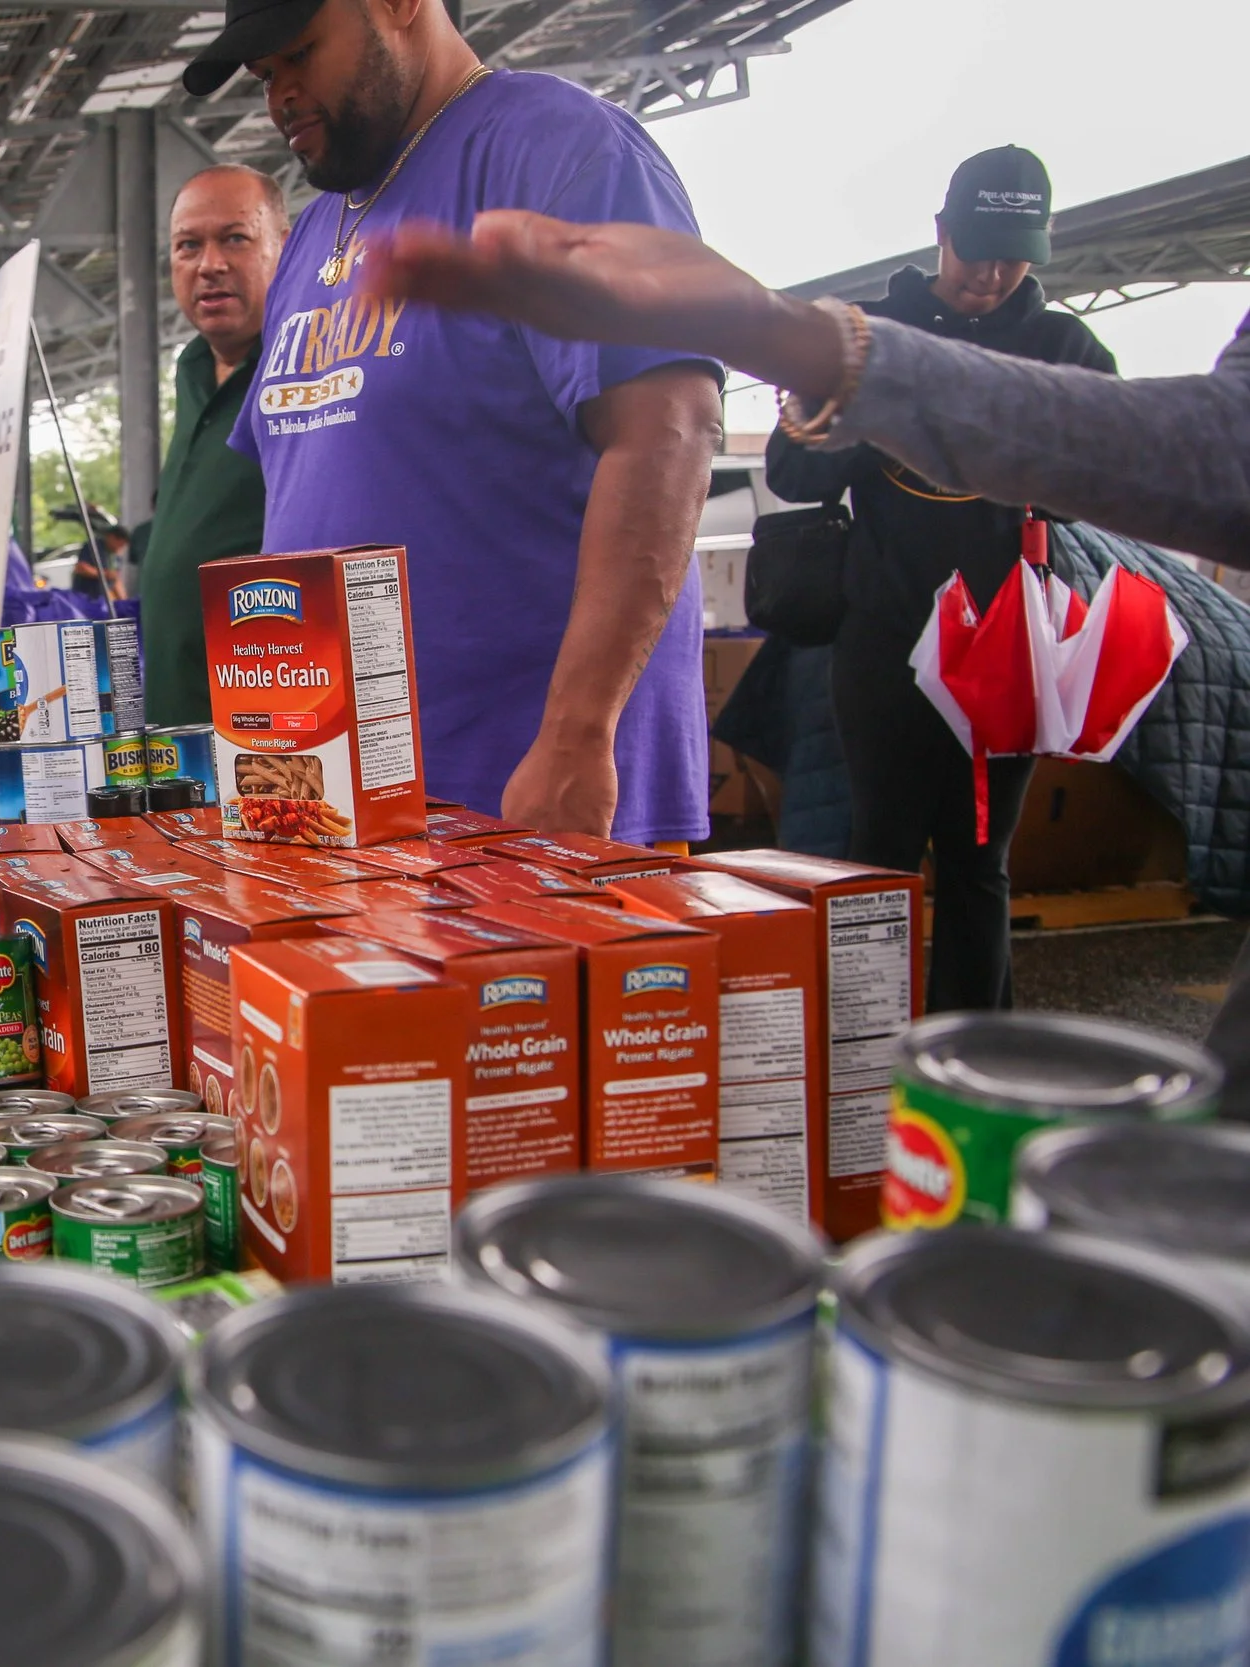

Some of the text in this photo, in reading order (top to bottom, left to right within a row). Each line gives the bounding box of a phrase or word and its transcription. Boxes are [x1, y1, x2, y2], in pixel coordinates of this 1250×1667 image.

[978, 190, 1042, 201] PHILABUNDANCE
[277, 374, 344, 408] FEST
[267, 420, 280, 435] The
[280, 417, 306, 434] Malcolm
[323, 407, 356, 426] Foundation
[345, 559, 396, 570] Nutrition Facts
[347, 584, 398, 599] Calories 180
[233, 589, 296, 617] RONZONI
[233, 643, 303, 658] Healthy Harvest
[215, 662, 330, 688] Whole Grain
[252, 738, 297, 750] Penne Rigate
[108, 749, 147, 771] BUSH
[150, 748, 175, 766] SH'S
[831, 893, 906, 909] Nutrition Facts
[78, 913, 157, 929] Nutrition Facts
[80, 935, 102, 943] Serving
[831, 924, 907, 944] Calories 180
[81, 942, 159, 961] Calories 180
[203, 939, 221, 962] Whole
[626, 971, 685, 991] RONZONI
[483, 983, 544, 1004] RONZONI
[85, 1001, 114, 1009] Cholesterol
[622, 1012, 654, 1023] Healthy
[42, 1022, 65, 1055] rain
[480, 1025, 512, 1037] Healthy
[603, 1021, 707, 1047] Whole Grain
[466, 1034, 568, 1063] Whole Grain
[616, 1047, 695, 1065] Penne Rigate
[475, 1061, 554, 1080] Penne Rigate
[9, 1233, 27, 1249] Del
